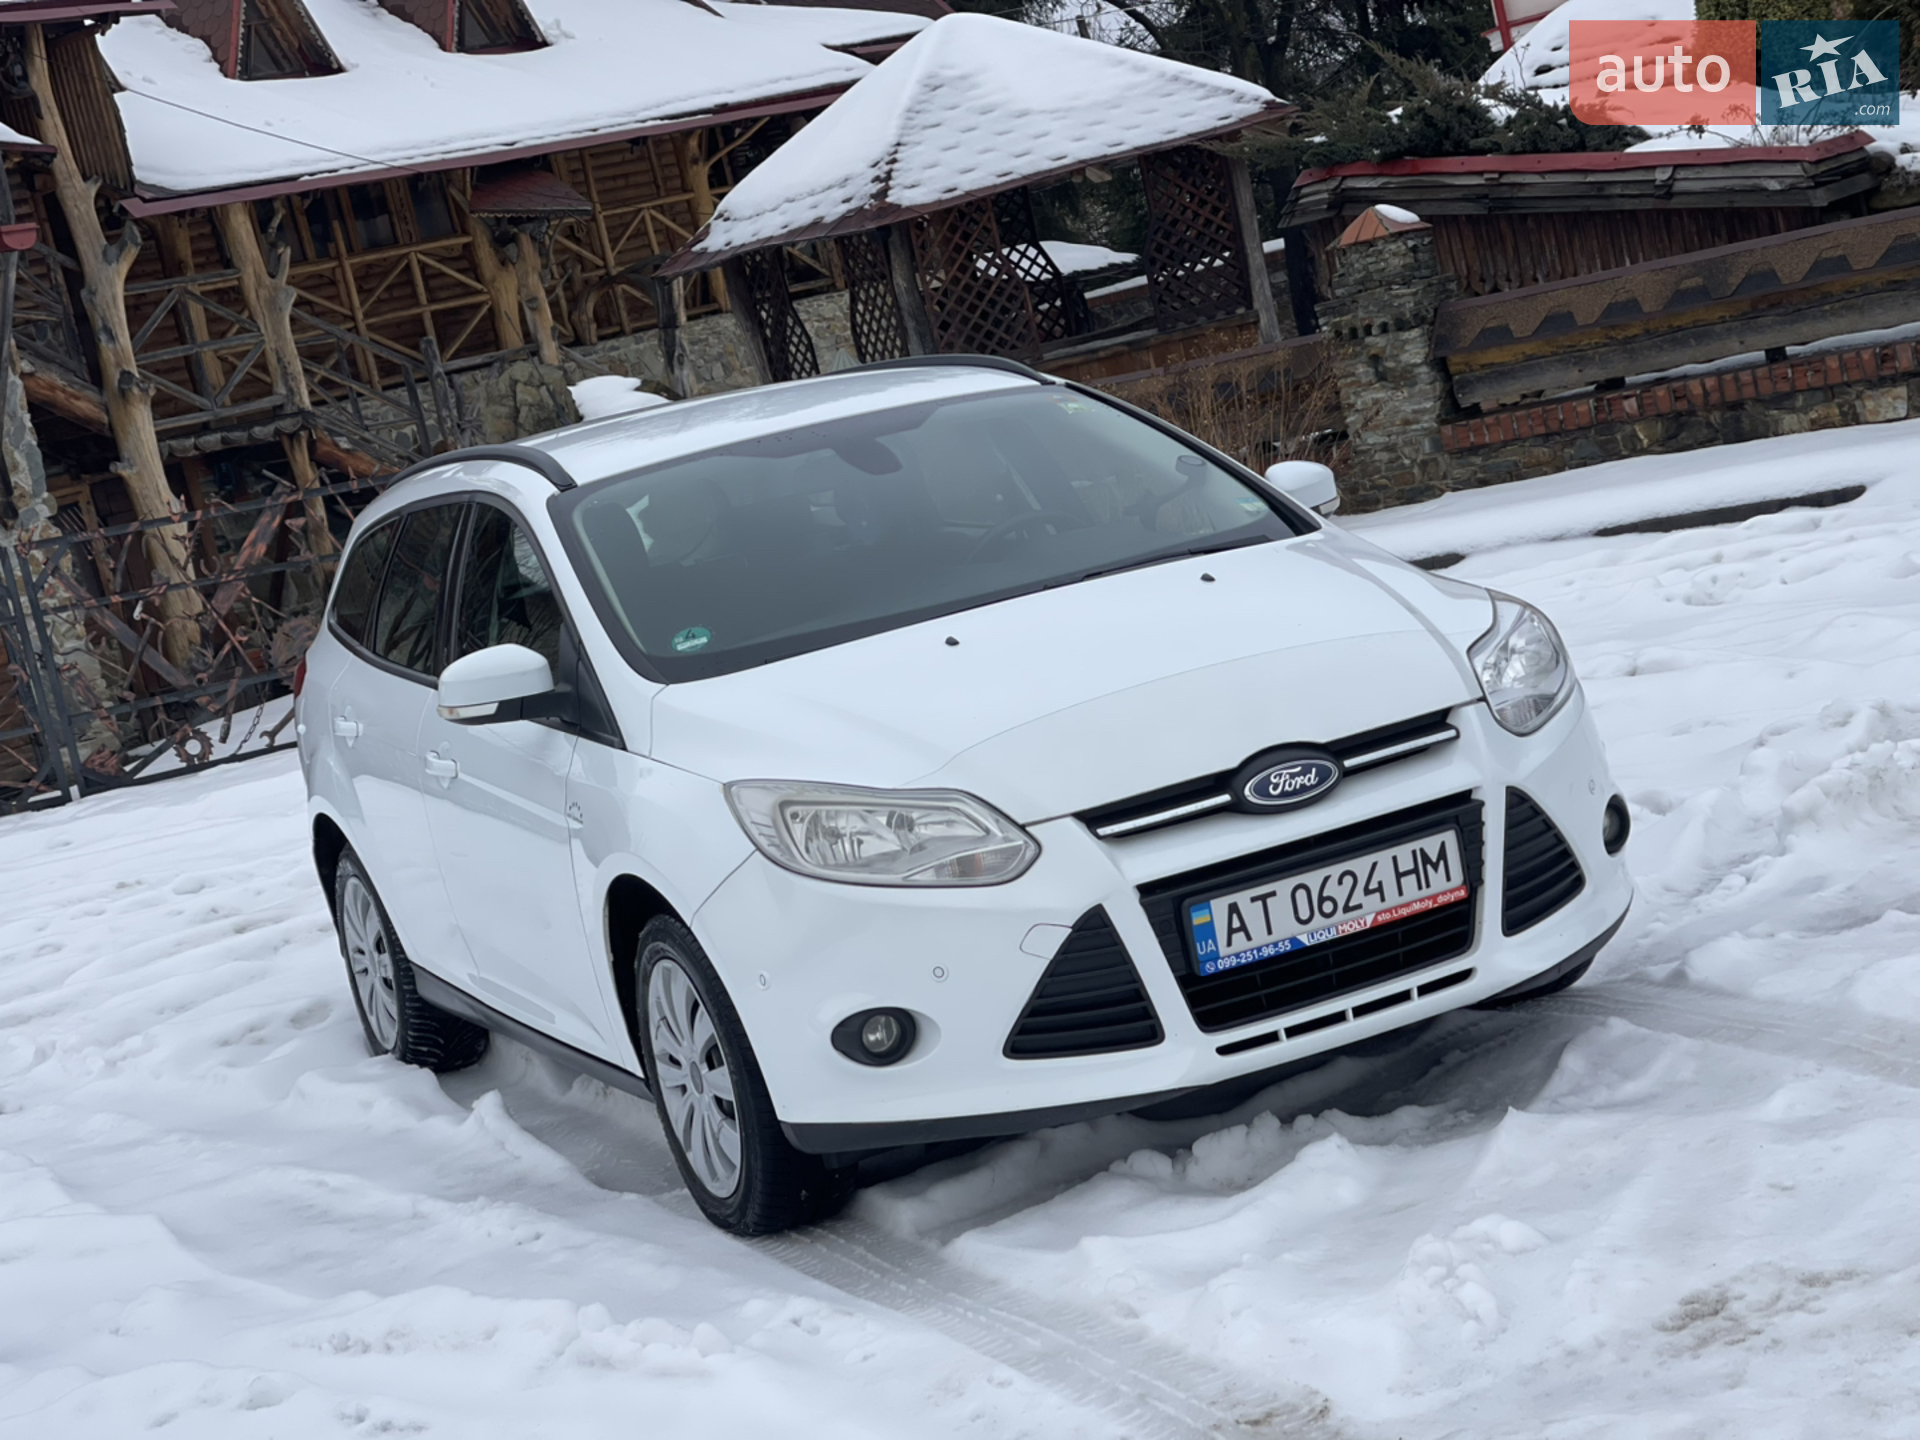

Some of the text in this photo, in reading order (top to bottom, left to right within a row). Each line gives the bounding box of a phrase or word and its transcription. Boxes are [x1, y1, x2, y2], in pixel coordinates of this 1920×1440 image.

[1268, 766, 1320, 796] Ford
[1226, 840, 1452, 948] AT 0624 HM
[1308, 917, 1367, 944] LIQUI MOLY
[1196, 938, 1217, 955] UA
[1216, 939, 1292, 970] 099-251-96-55
